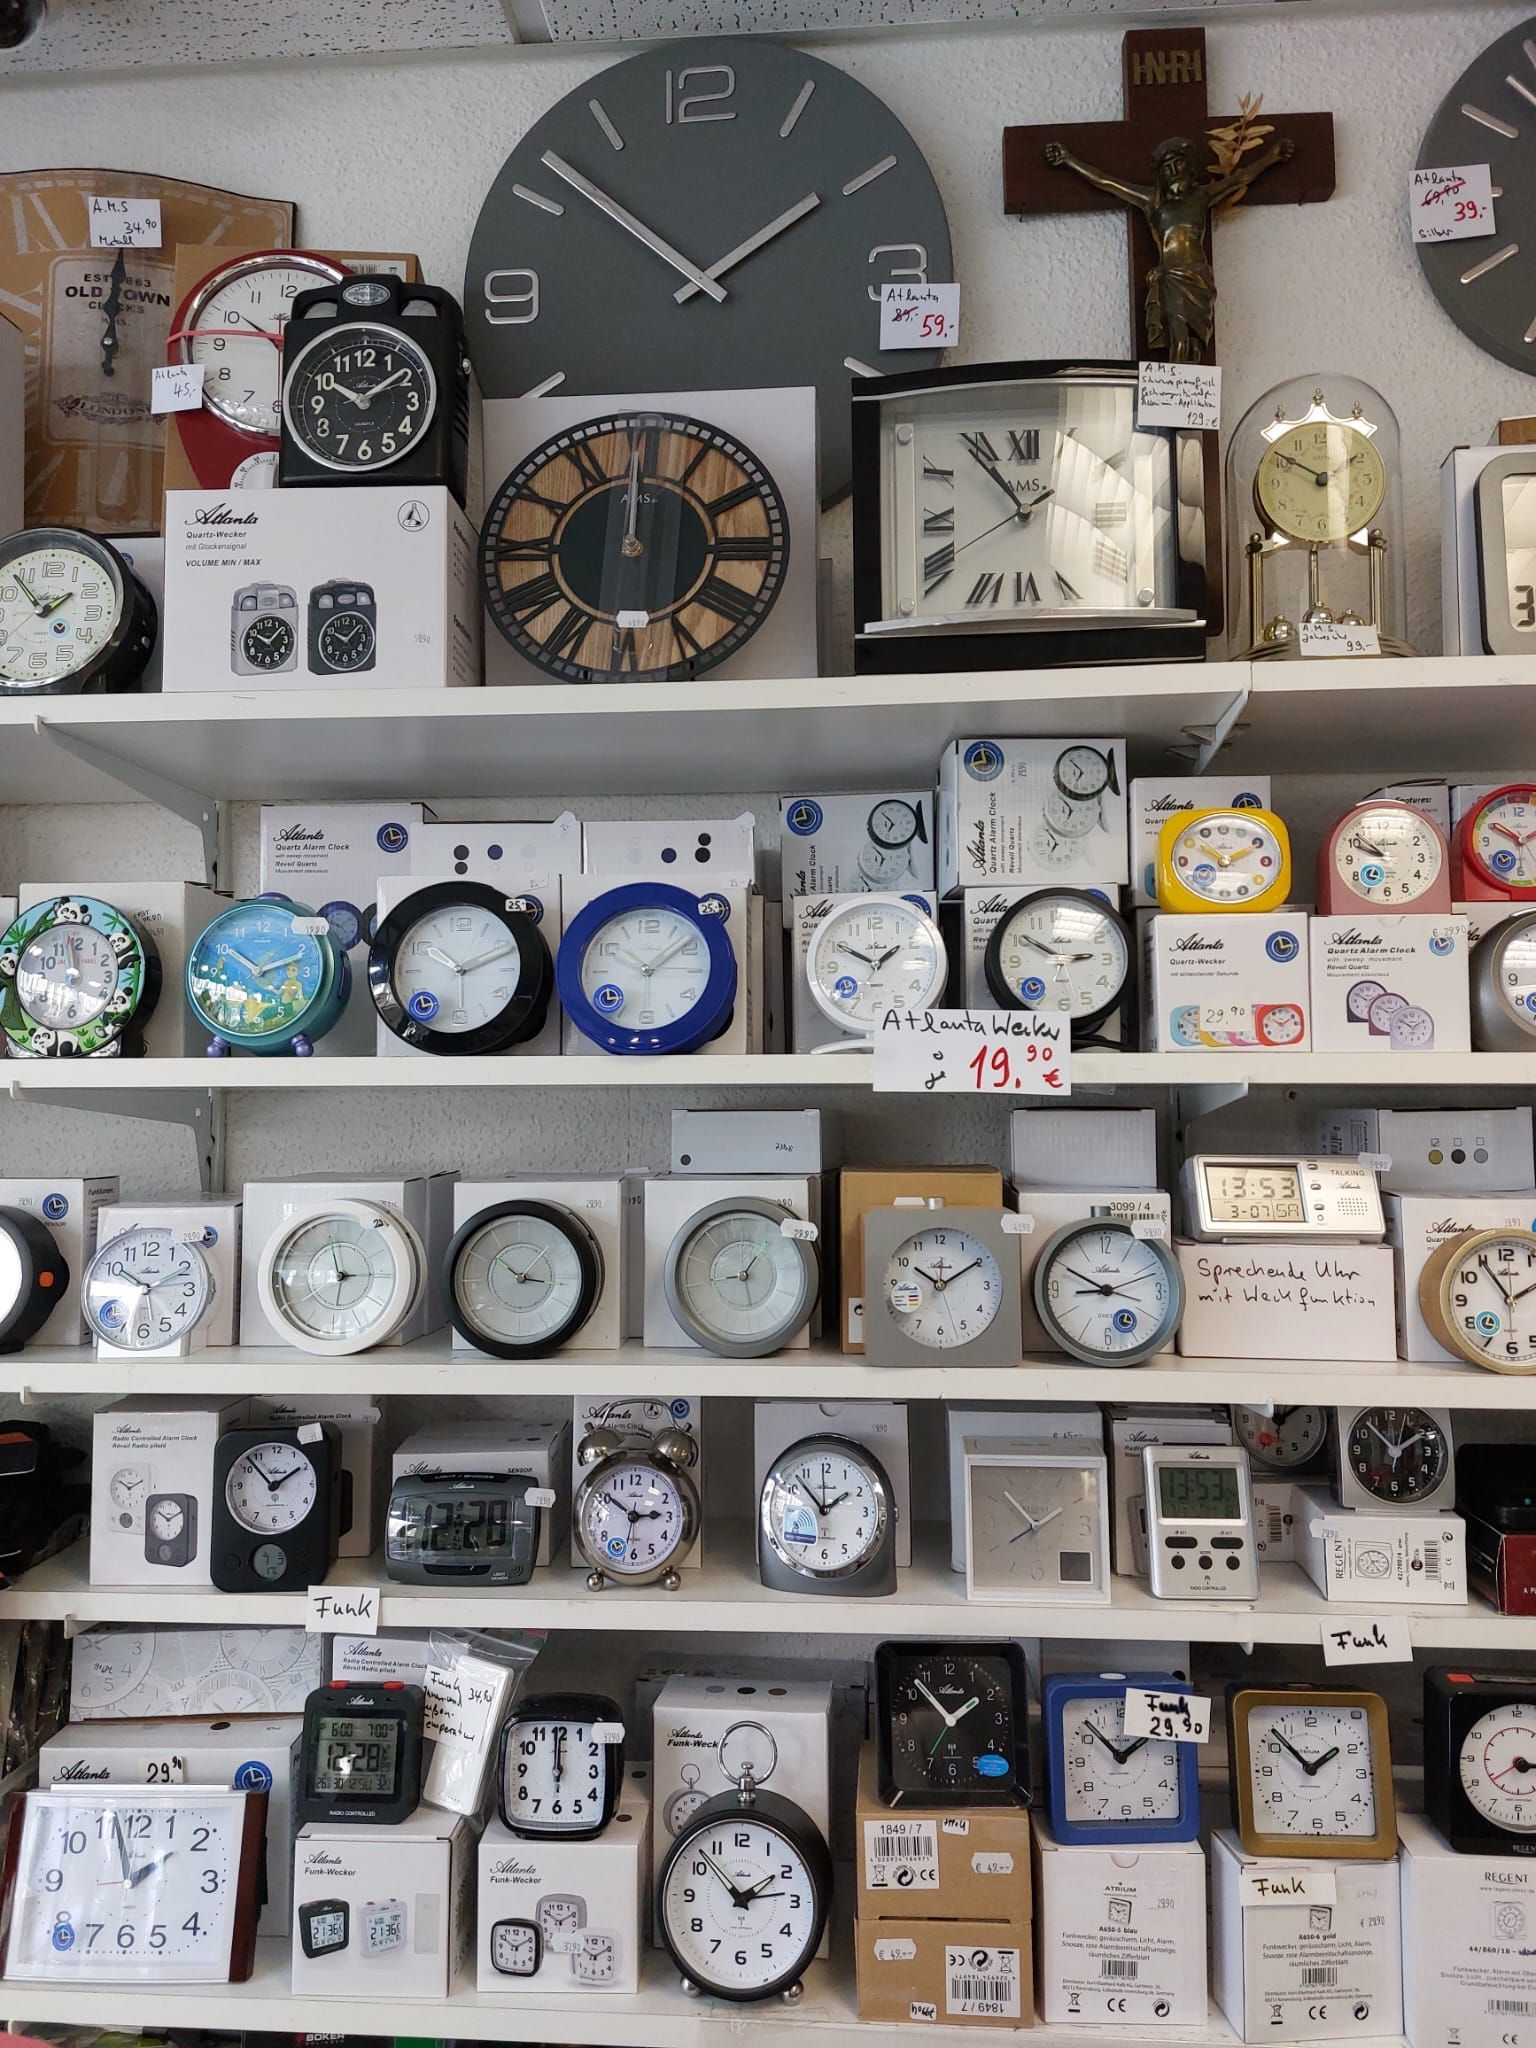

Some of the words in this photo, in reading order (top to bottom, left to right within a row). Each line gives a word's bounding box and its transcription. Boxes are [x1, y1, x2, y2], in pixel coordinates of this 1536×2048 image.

[1133, 49, 1202, 85] INRI
[666, 65, 737, 124] 12
[1414, 172, 1464, 186] Atlanta
[868, 243, 927, 301] 3
[484, 269, 539, 324] 9
[886, 286, 939, 304] Atlanta
[354, 349, 375, 368] 12
[357, 441, 371, 460] 6
[381, 433, 396, 453] 5
[1008, 429, 1040, 460] XII
[185, 503, 259, 526] Atlanta
[185, 530, 247, 540] Quartz-Wecker
[185, 543, 197, 551] mit
[198, 542, 247, 552] Glockensignal
[42, 561, 65, 578] 12
[185, 559, 219, 567] VOLUME
[221, 559, 236, 567] MIN
[244, 558, 262, 566] MAX
[83, 605, 103, 621] 3
[29, 652, 47, 669] 6
[989, 792, 997, 817] Clock
[1145, 794, 1196, 812] Atlanta
[273, 823, 324, 842] Atlanta
[989, 818, 997, 843] Alarm
[275, 843, 300, 852] Quartz
[966, 819, 986, 876] Atlanta
[989, 845, 997, 873] Quartz
[1169, 931, 1224, 953] Atlanta
[1324, 927, 1382, 947] Atlanta
[1327, 946, 1360, 955] Quartz
[1360, 946, 1388, 954] Alarm
[1390, 946, 1416, 954] Clock
[1169, 958, 1226, 966] Quartz-Wecker
[882, 1009, 986, 1035] Atlanta
[1042, 1068, 1063, 1088] €
[1330, 1169, 1365, 1177] TALKING
[1110, 1202, 1135, 1211] 3099
[1143, 1202, 1150, 1211] 4
[141, 1242, 160, 1258] 12
[1100, 1235, 1111, 1254] 12
[1498, 1249, 1515, 1261] 12
[1197, 1259, 1307, 1280] Sprechende
[1315, 1259, 1360, 1279] Uhr
[1461, 1272, 1478, 1284] 10
[1198, 1289, 1233, 1303] mit
[174, 1302, 187, 1317] 4
[158, 1318, 172, 1332] 5
[1506, 1341, 1519, 1354] 6
[404, 1461, 443, 1475] Atlanta
[1335, 1539, 1344, 1580] REGENT
[313, 1594, 372, 1618] Funk
[1331, 1624, 1388, 1650] Funk
[342, 1642, 382, 1657] Atlanta
[532, 1727, 546, 1741] 11
[667, 1726, 703, 1739] Atlanta
[519, 1741, 535, 1756] 10
[53, 1759, 110, 1782] Atlanta
[124, 1815, 152, 1839] 12
[880, 1824, 906, 1834] 1849
[916, 1824, 922, 1833] 7
[62, 1830, 87, 1855] 10
[190, 1827, 210, 1851] 2
[734, 1833, 750, 1848] 12
[304, 1851, 342, 1867] Atlanta
[489, 1857, 537, 1874] Atlanta
[304, 1867, 356, 1877] Funk-Wecker
[692, 1861, 707, 1876] 10
[44, 1868, 63, 1892] 9
[489, 1875, 542, 1885] Funk-Wecker
[1251, 1877, 1306, 1896] Funk
[1485, 1872, 1528, 1884] REGENT
[182, 1911, 201, 1936] 4
[779, 1922, 793, 1937] 4
[761, 1943, 773, 1958] 5
